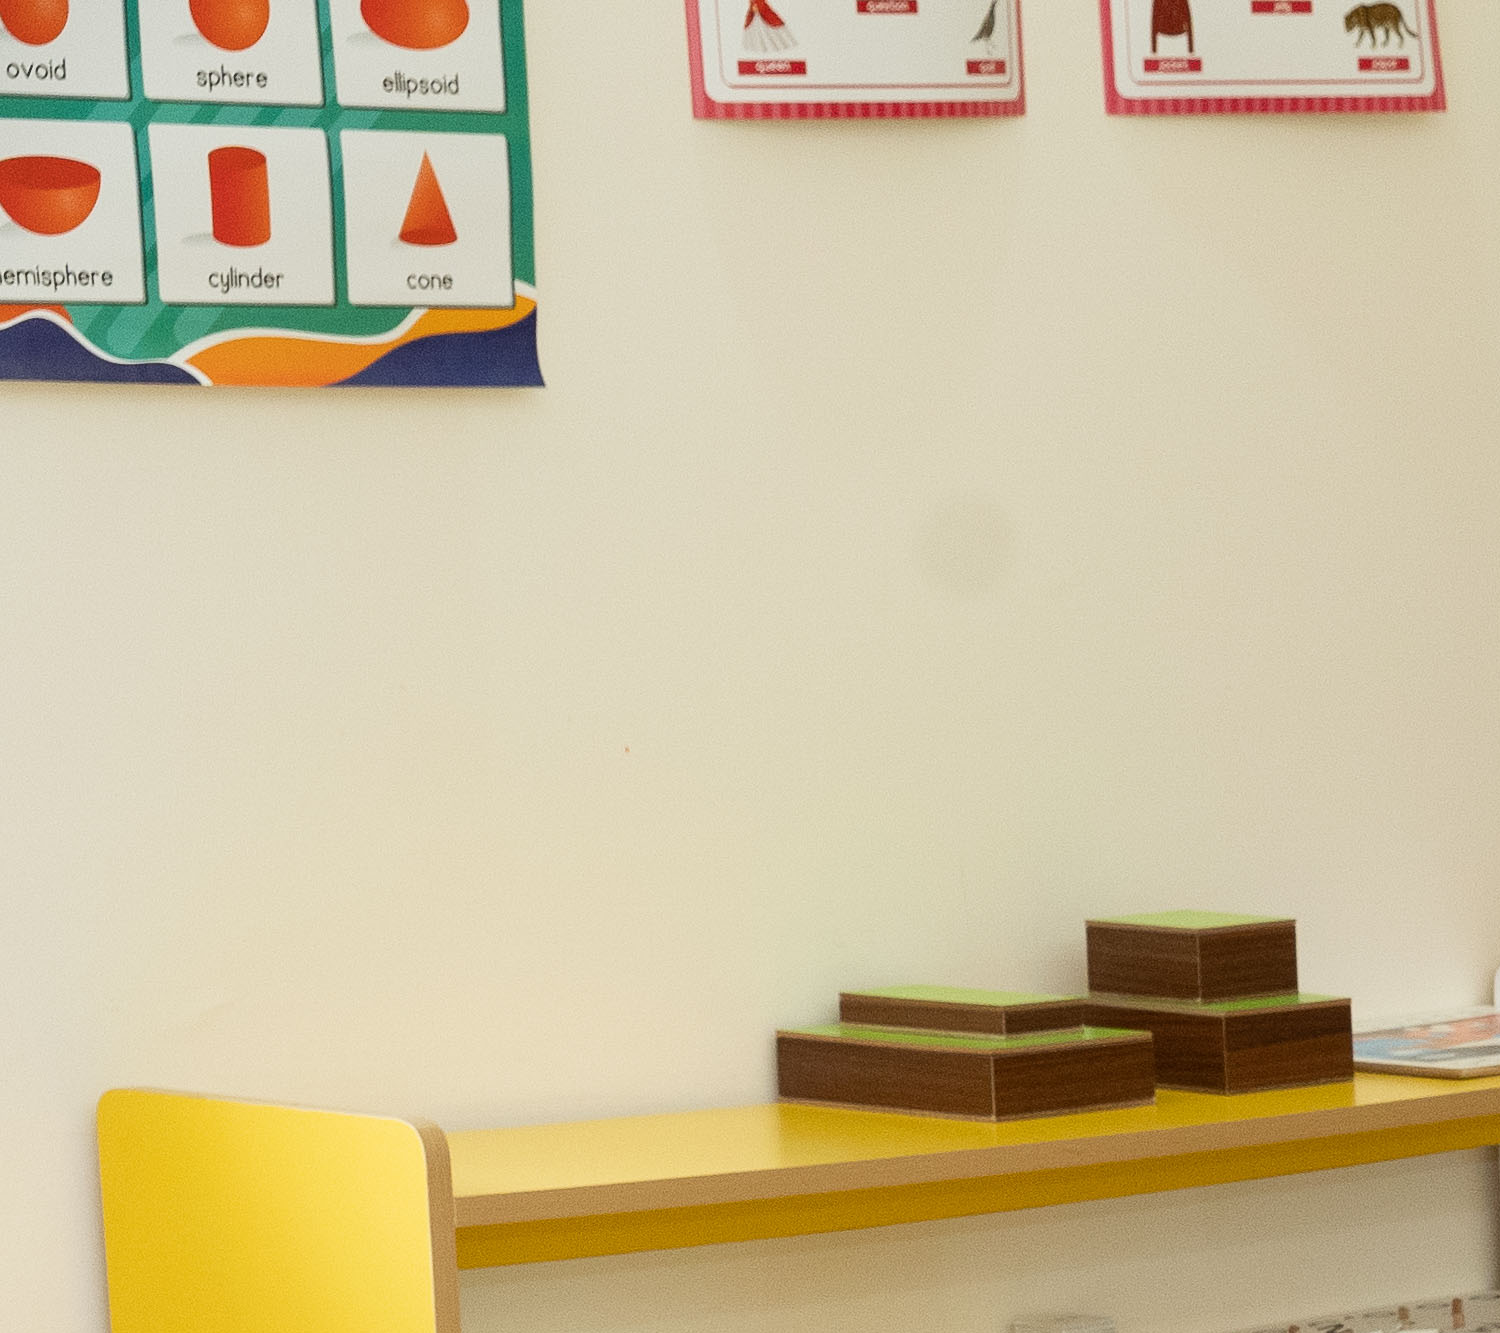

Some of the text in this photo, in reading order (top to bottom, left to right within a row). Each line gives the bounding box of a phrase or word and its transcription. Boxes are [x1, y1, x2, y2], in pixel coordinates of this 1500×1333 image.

[6, 58, 67, 80] ovoid
[196, 64, 268, 92] sphere
[381, 73, 460, 98] ellipsoid
[0, 264, 114, 292] emisphere
[208, 267, 284, 294] cylinder
[406, 272, 453, 291] cone
